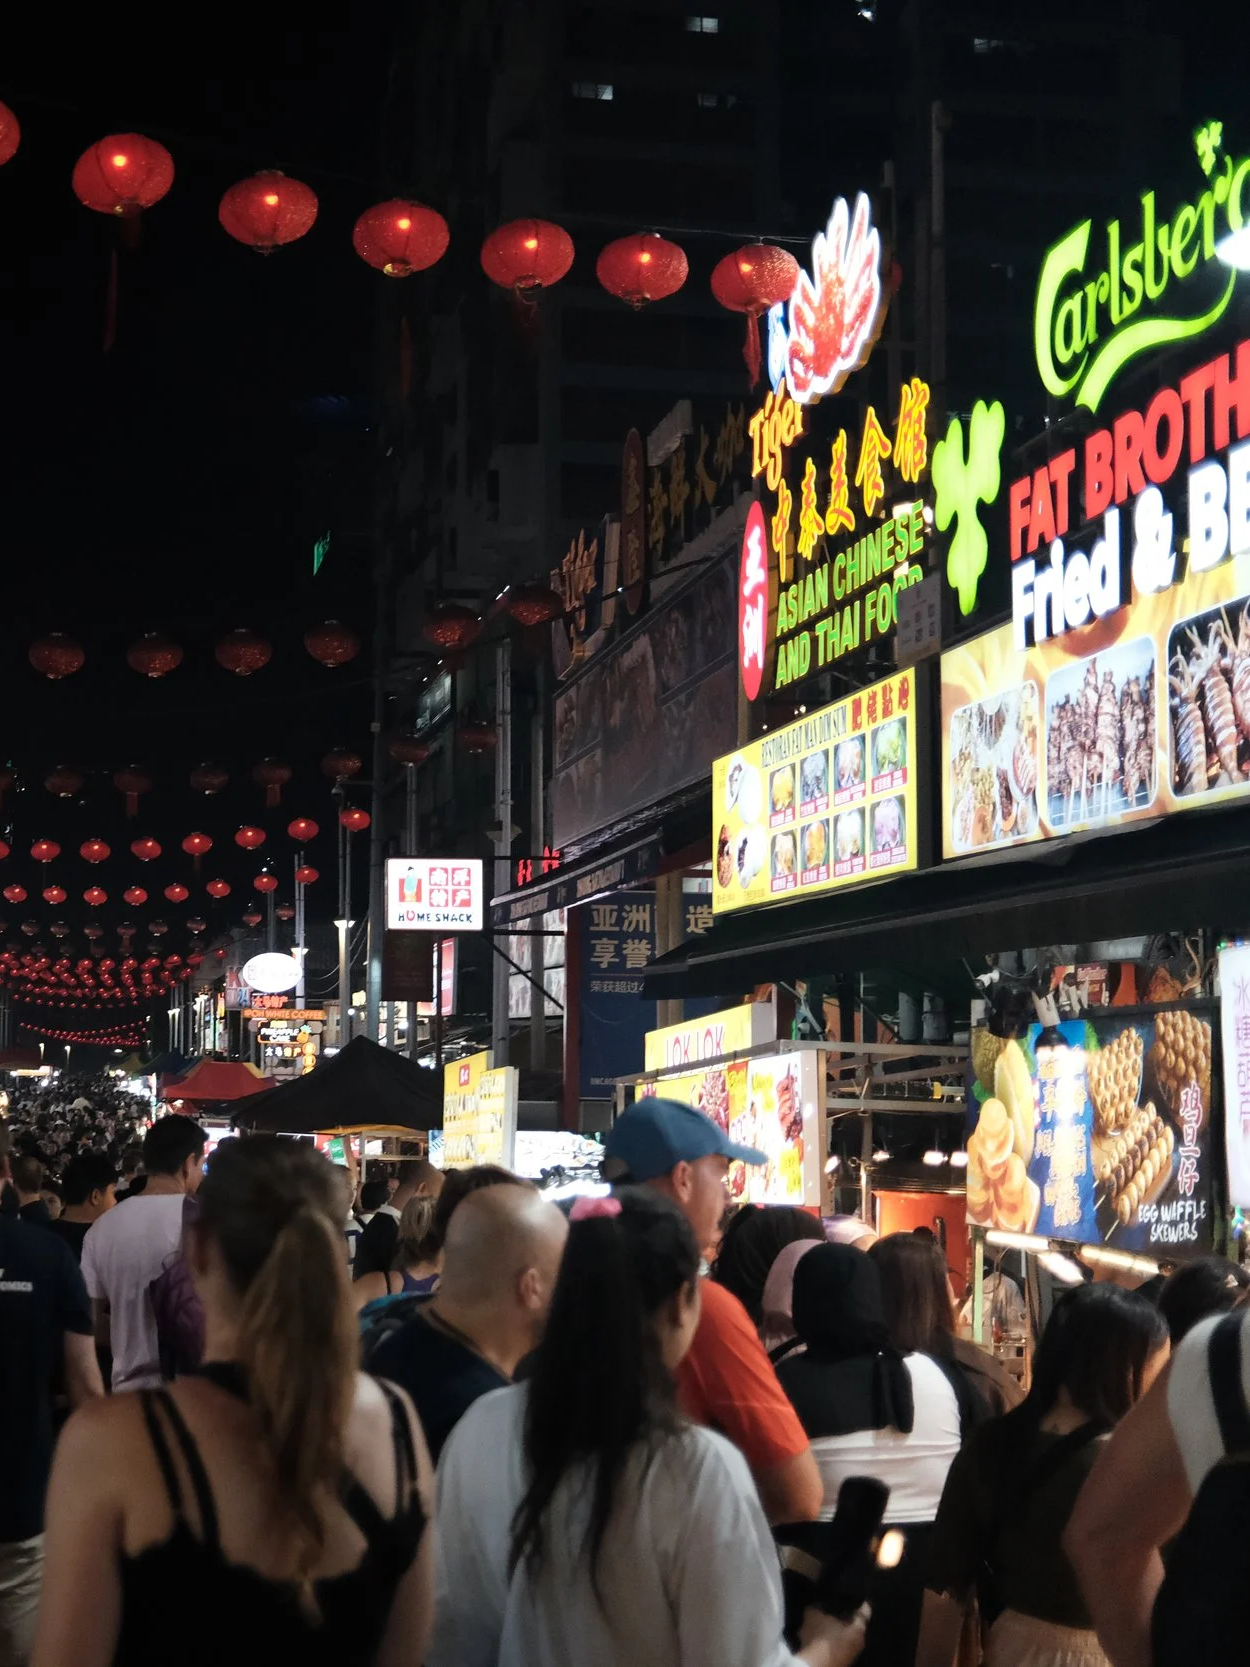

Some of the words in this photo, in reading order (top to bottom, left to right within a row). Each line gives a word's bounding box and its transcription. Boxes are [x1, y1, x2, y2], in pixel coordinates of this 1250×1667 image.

[748, 384, 804, 492] Tiger
[1010, 448, 1076, 562] FAT
[776, 562, 829, 637] ASIAN
[833, 499, 924, 601] CHINESE
[1011, 505, 1120, 652] Fried
[1131, 485, 1177, 596] &
[775, 630, 811, 690] AND
[815, 600, 860, 667] THAI
[398, 910, 431, 922] HOME
[435, 913, 473, 923] SHACK
[266, 1010, 290, 1018] WHITE
[291, 1010, 324, 1019] COFFEE
[1138, 1203, 1159, 1222] EGG
[1161, 1200, 1207, 1221] WAFFLE
[1150, 1221, 1198, 1243] SKEWERS
